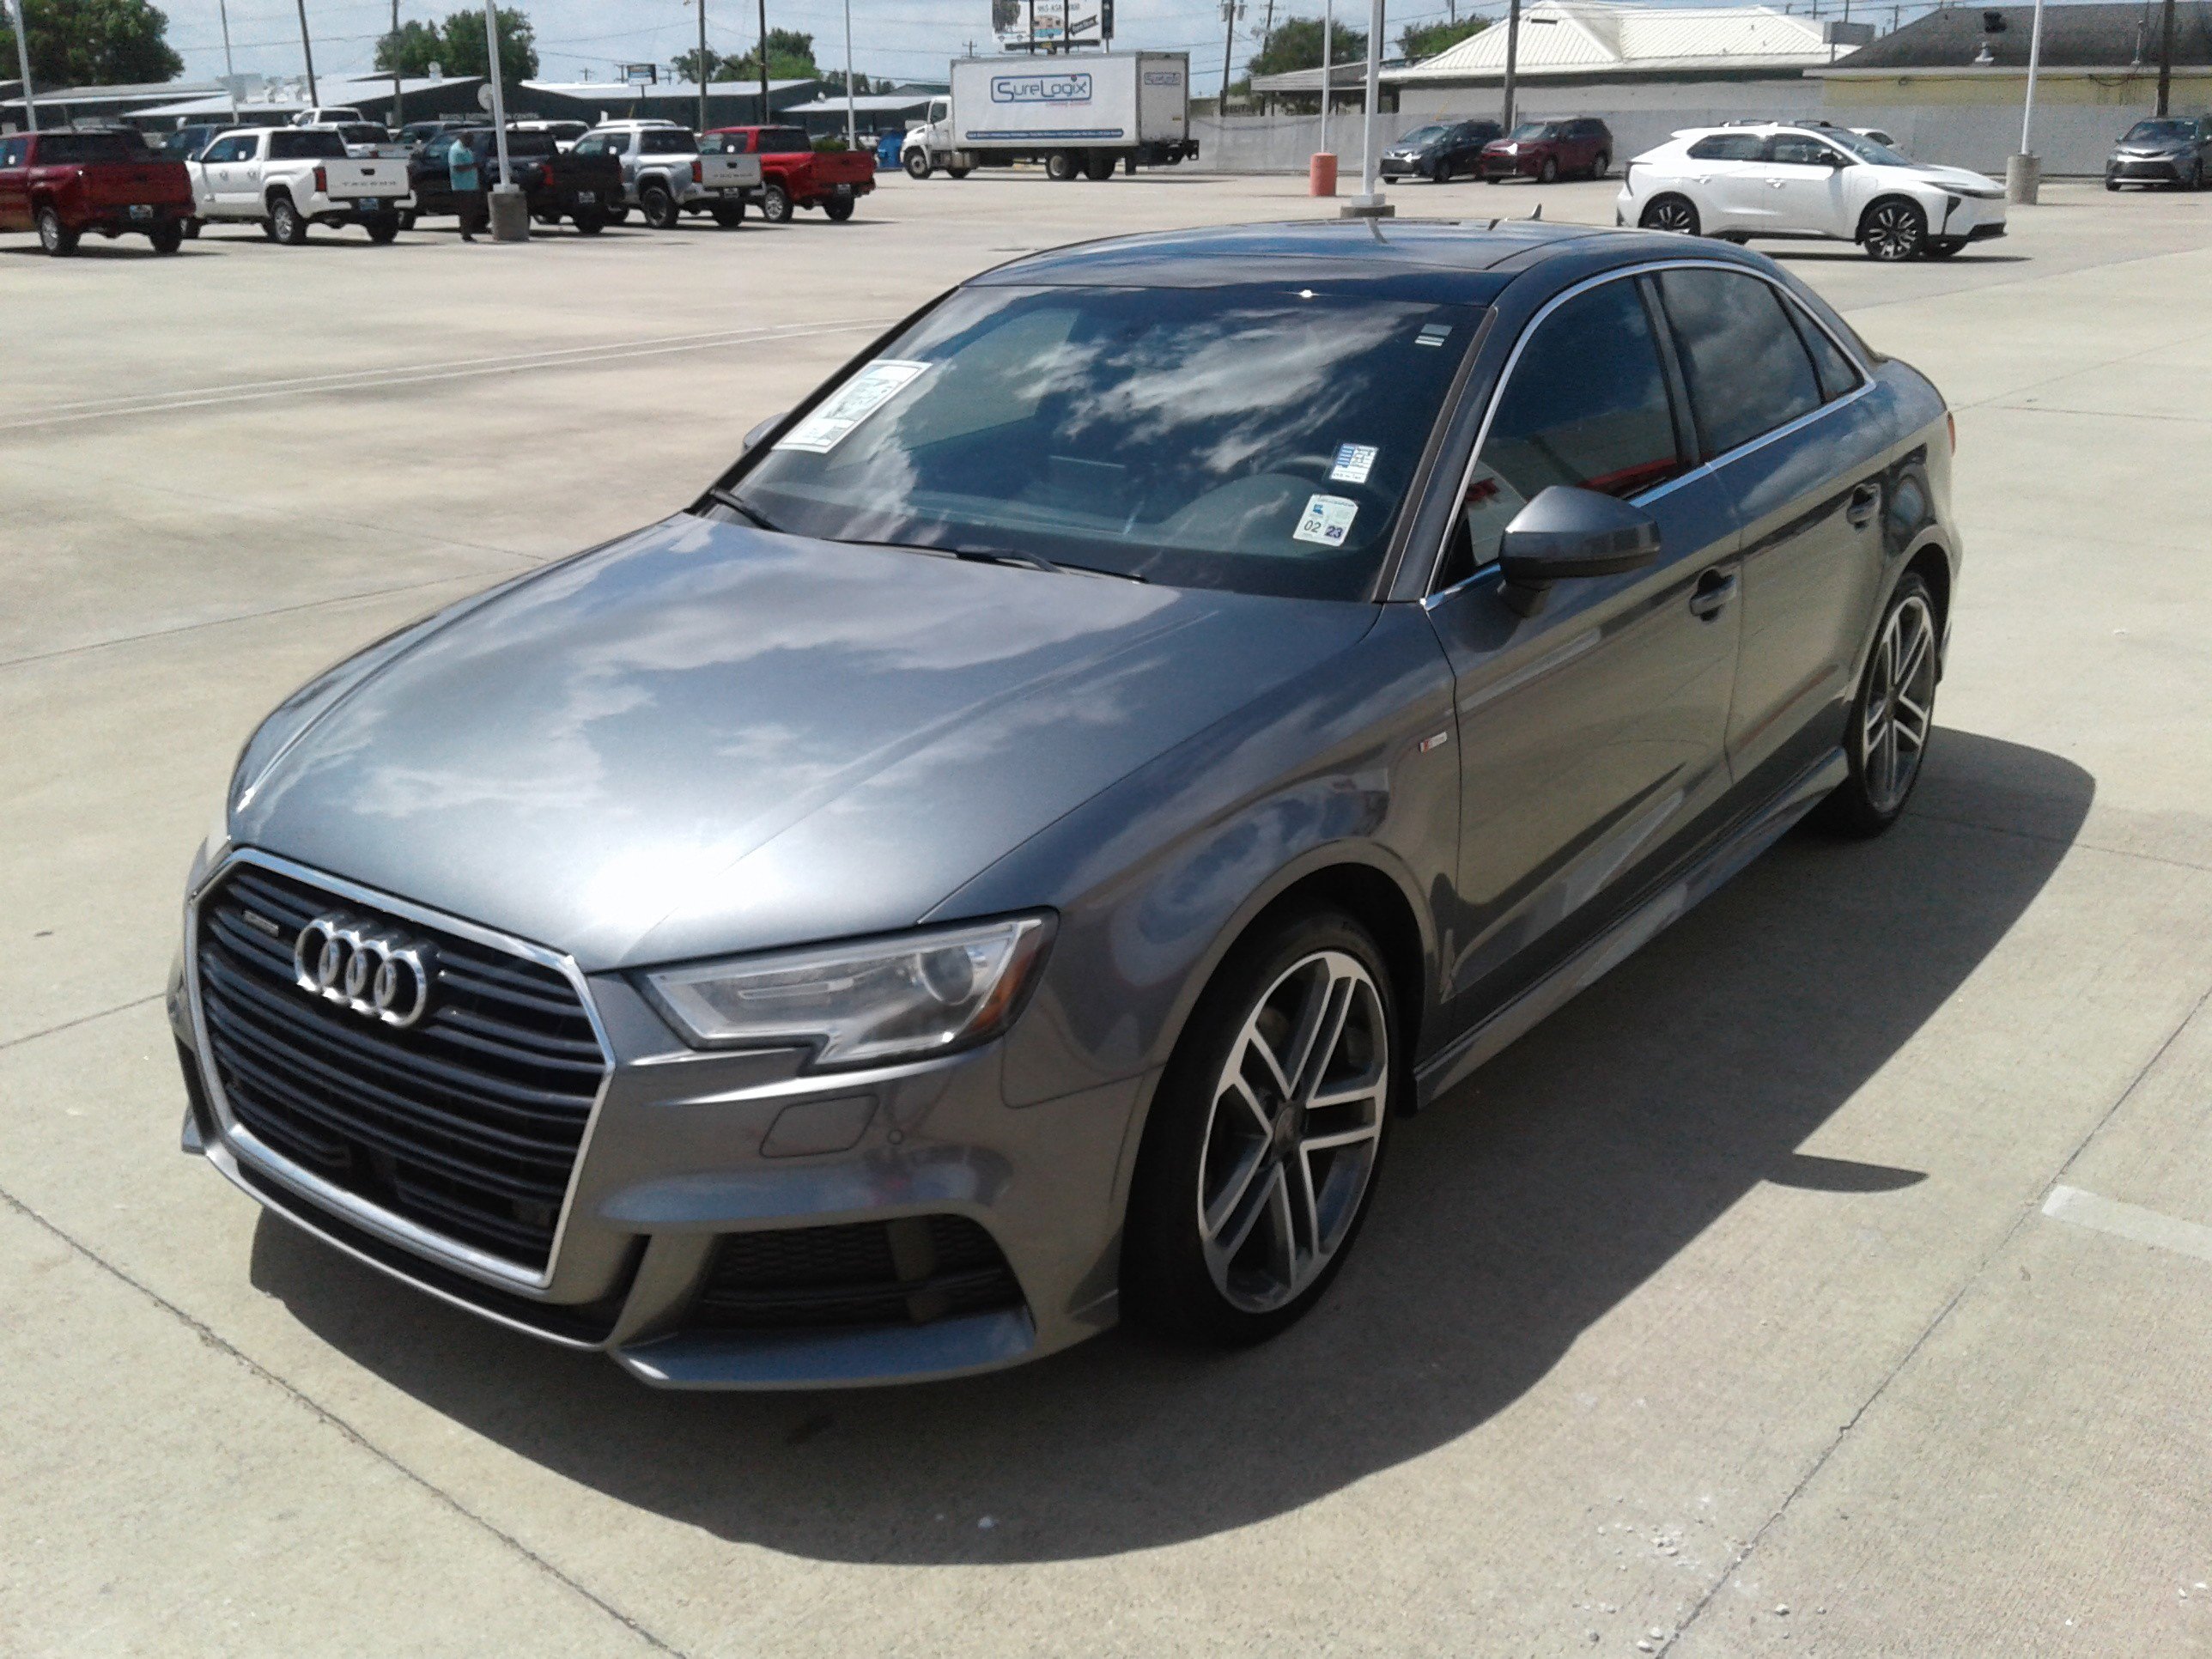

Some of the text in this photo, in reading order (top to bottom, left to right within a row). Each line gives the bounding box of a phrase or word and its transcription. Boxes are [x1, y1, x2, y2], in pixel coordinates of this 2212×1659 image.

[997, 75, 1086, 102] SureLogix
[1304, 520, 1343, 538] 02 23
